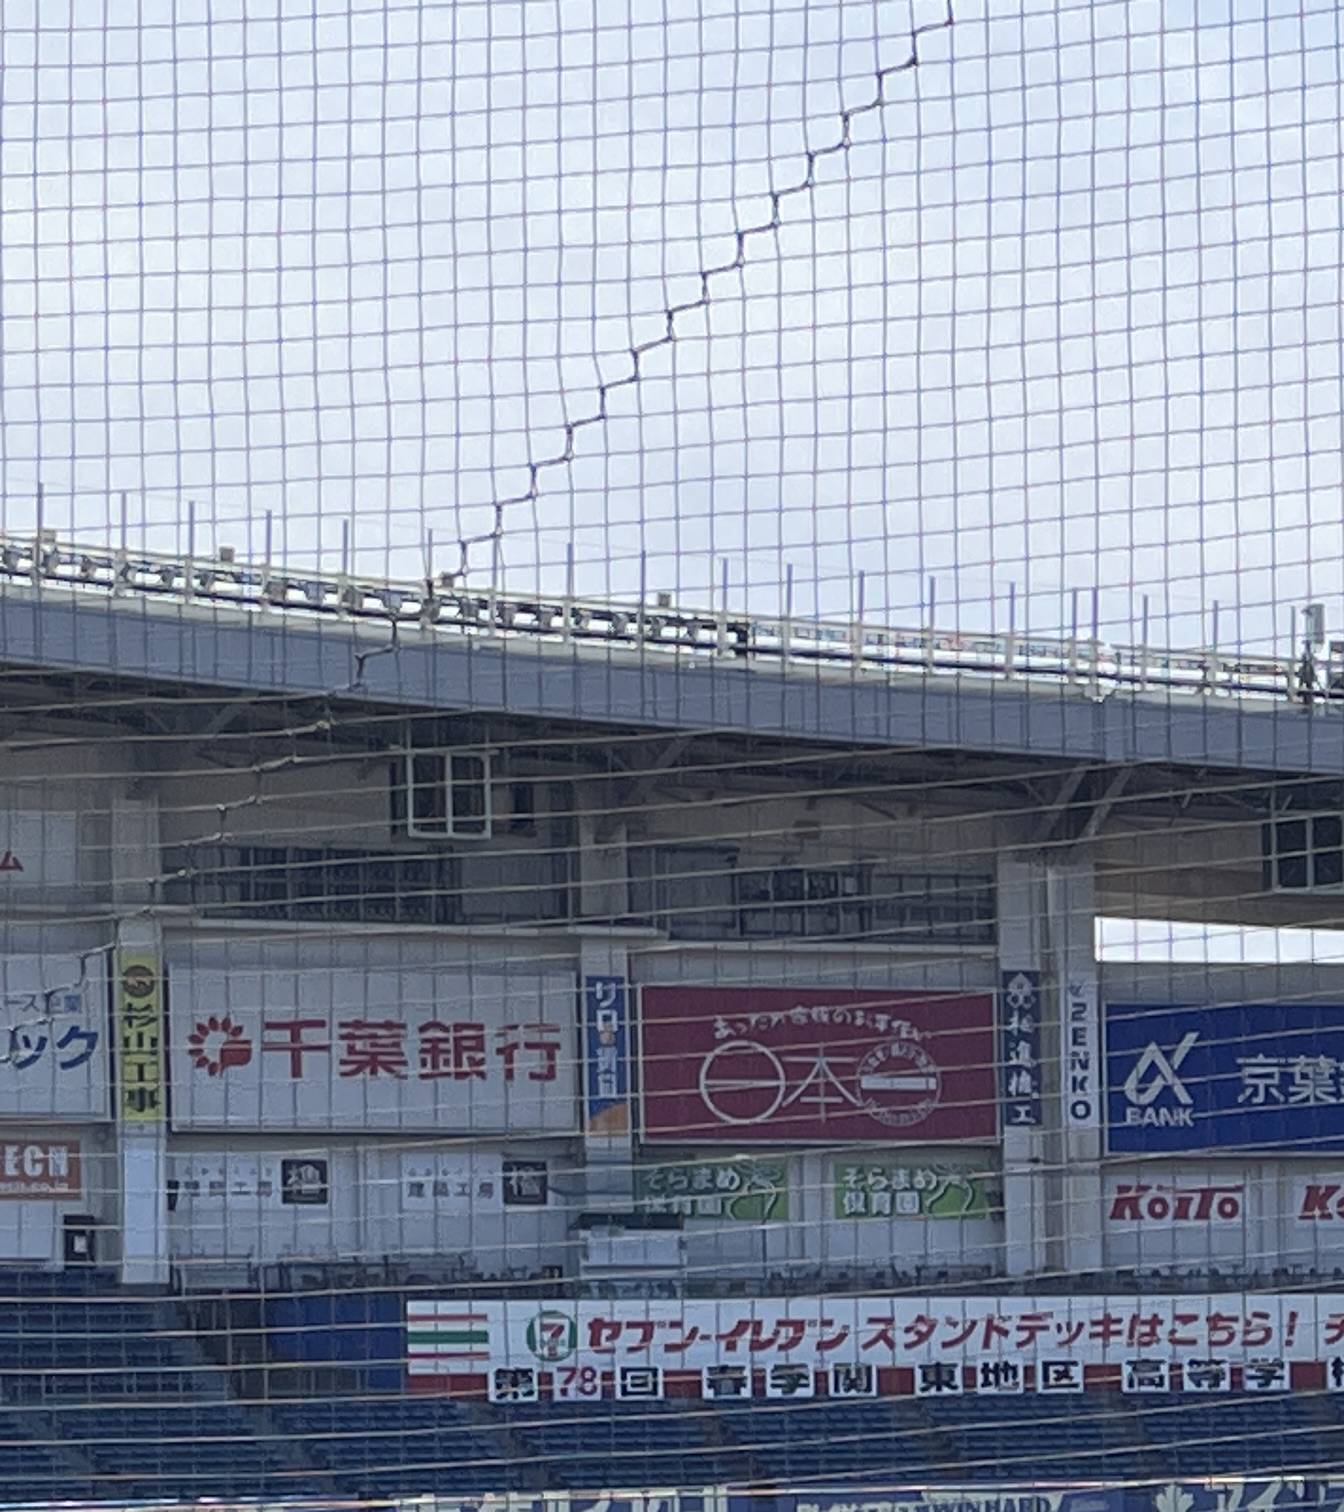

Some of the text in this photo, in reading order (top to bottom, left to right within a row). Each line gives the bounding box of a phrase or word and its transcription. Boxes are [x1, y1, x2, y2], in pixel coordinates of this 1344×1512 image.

[261, 1017, 563, 1082] 千葉銀行
[1126, 1107, 1195, 1128] BANK
[843, 1167, 938, 1191] そらまめ
